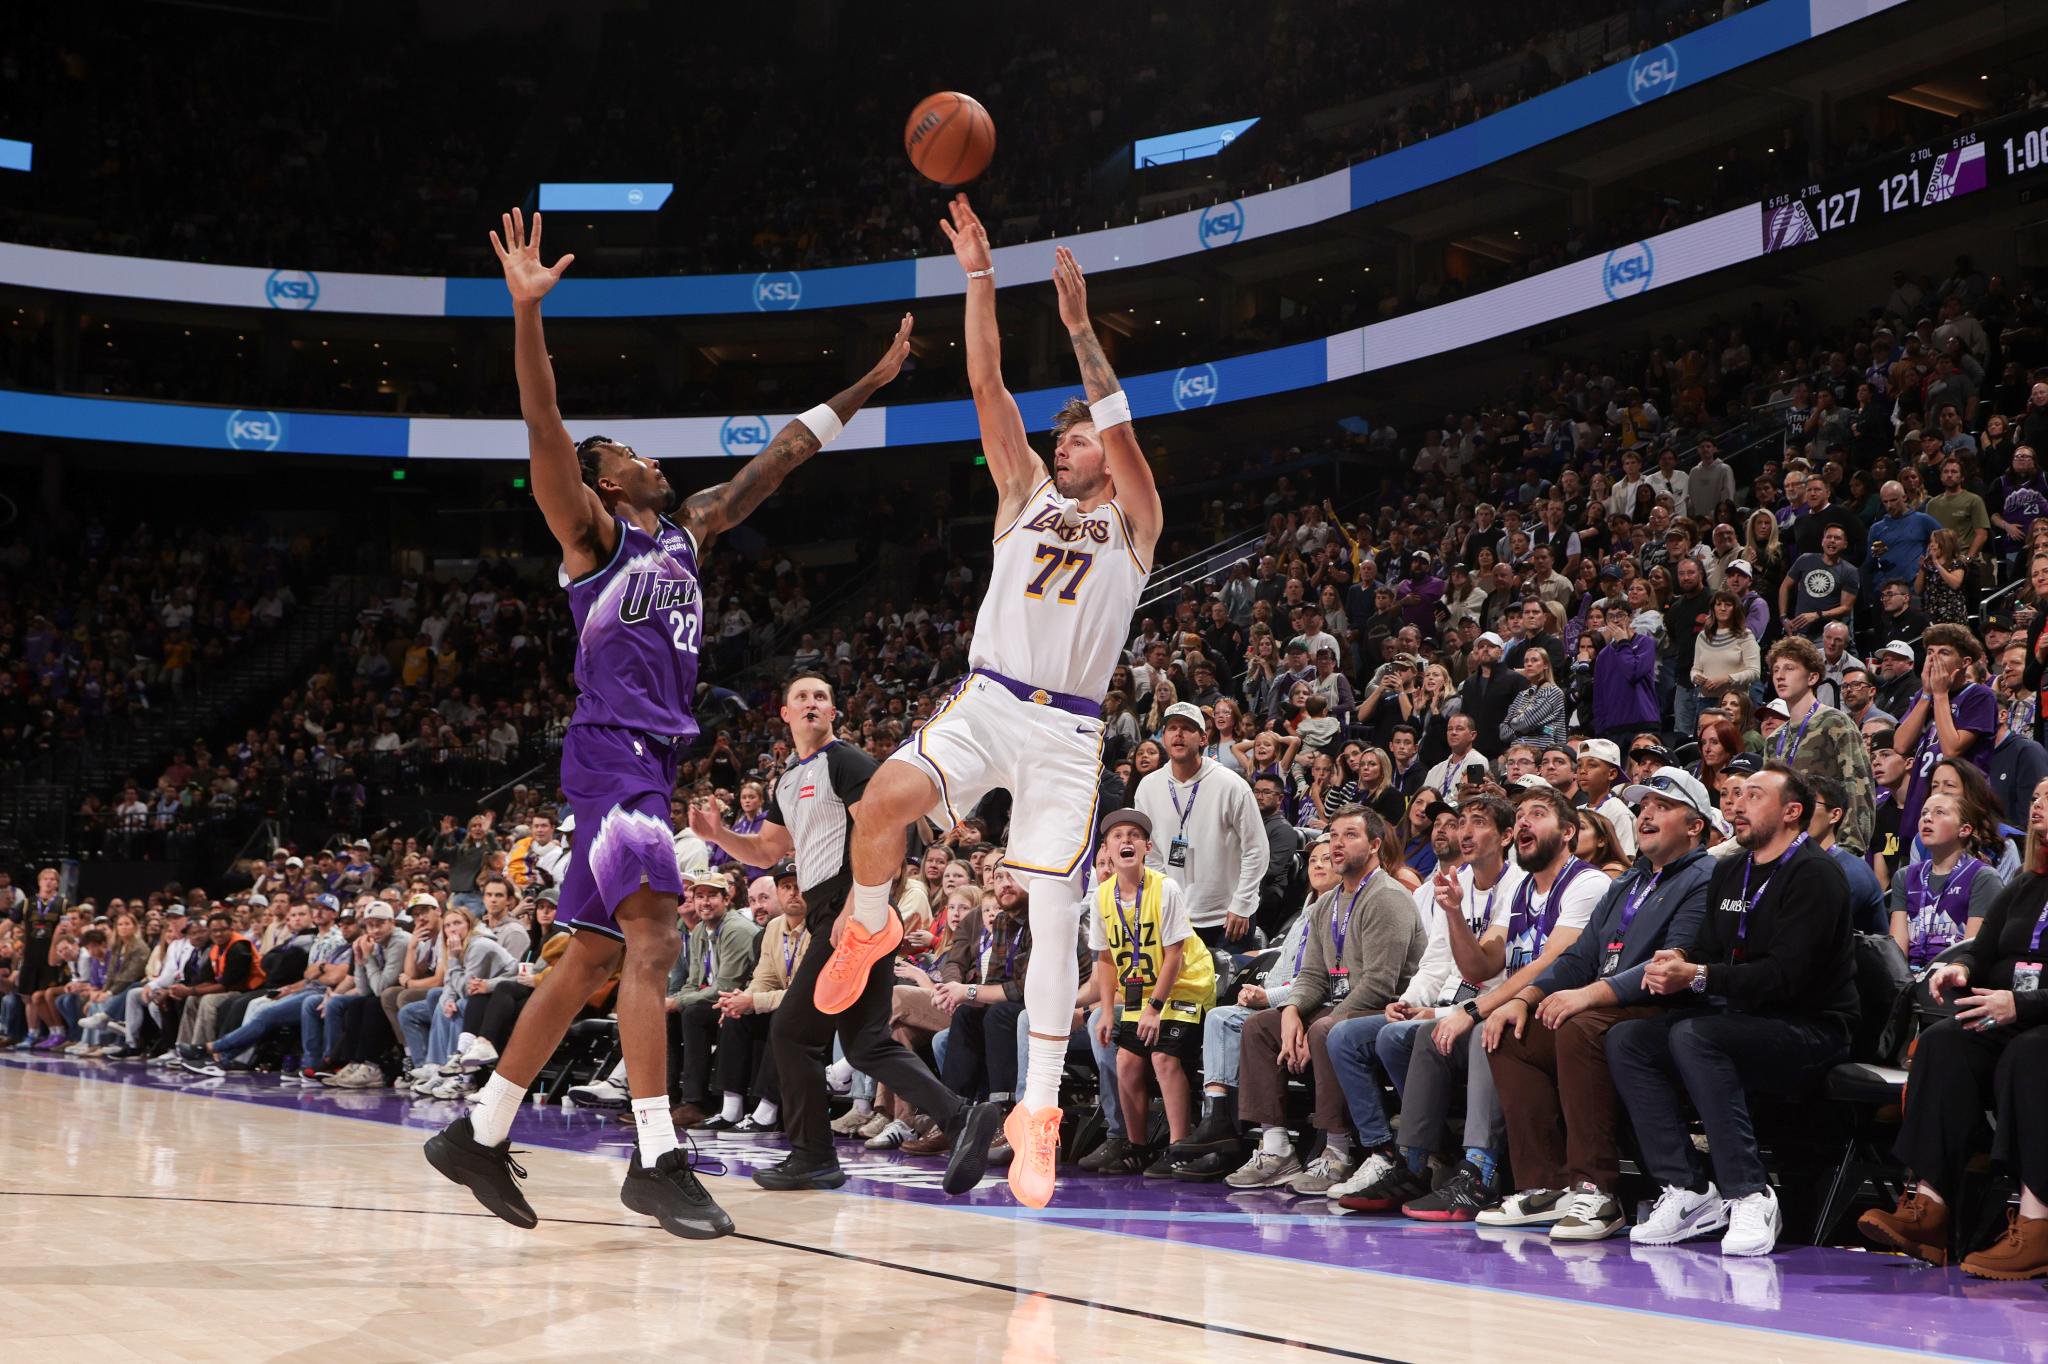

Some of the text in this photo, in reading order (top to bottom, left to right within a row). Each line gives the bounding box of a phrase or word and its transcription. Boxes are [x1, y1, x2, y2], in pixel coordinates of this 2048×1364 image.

[1634, 57, 1677, 92] KSL
[1952, 133, 1976, 148] 5 FLS
[1910, 148, 1933, 164] 2 TOL
[1801, 184, 1822, 198] 2 TOL
[1878, 169, 1920, 213] 121
[1926, 158, 1945, 202] BONUS
[1776, 194, 1790, 206] FLS
[1817, 187, 1860, 232] 127
[1204, 212, 1242, 239] KSL
[1795, 203, 1816, 239] BONUS
[1608, 257, 1652, 287] KSL
[273, 281, 316, 300] KSL
[759, 282, 800, 301] KSL
[1179, 375, 1217, 400] KSL
[233, 421, 281, 442] KSL
[727, 426, 770, 445] KSL
[2023, 503, 2040, 515] 23
[1023, 503, 1110, 544] LAKERS
[665, 542, 687, 552] Equity
[1024, 543, 1093, 606] 77
[669, 610, 699, 654] 22
[1116, 951, 1158, 987] 23
